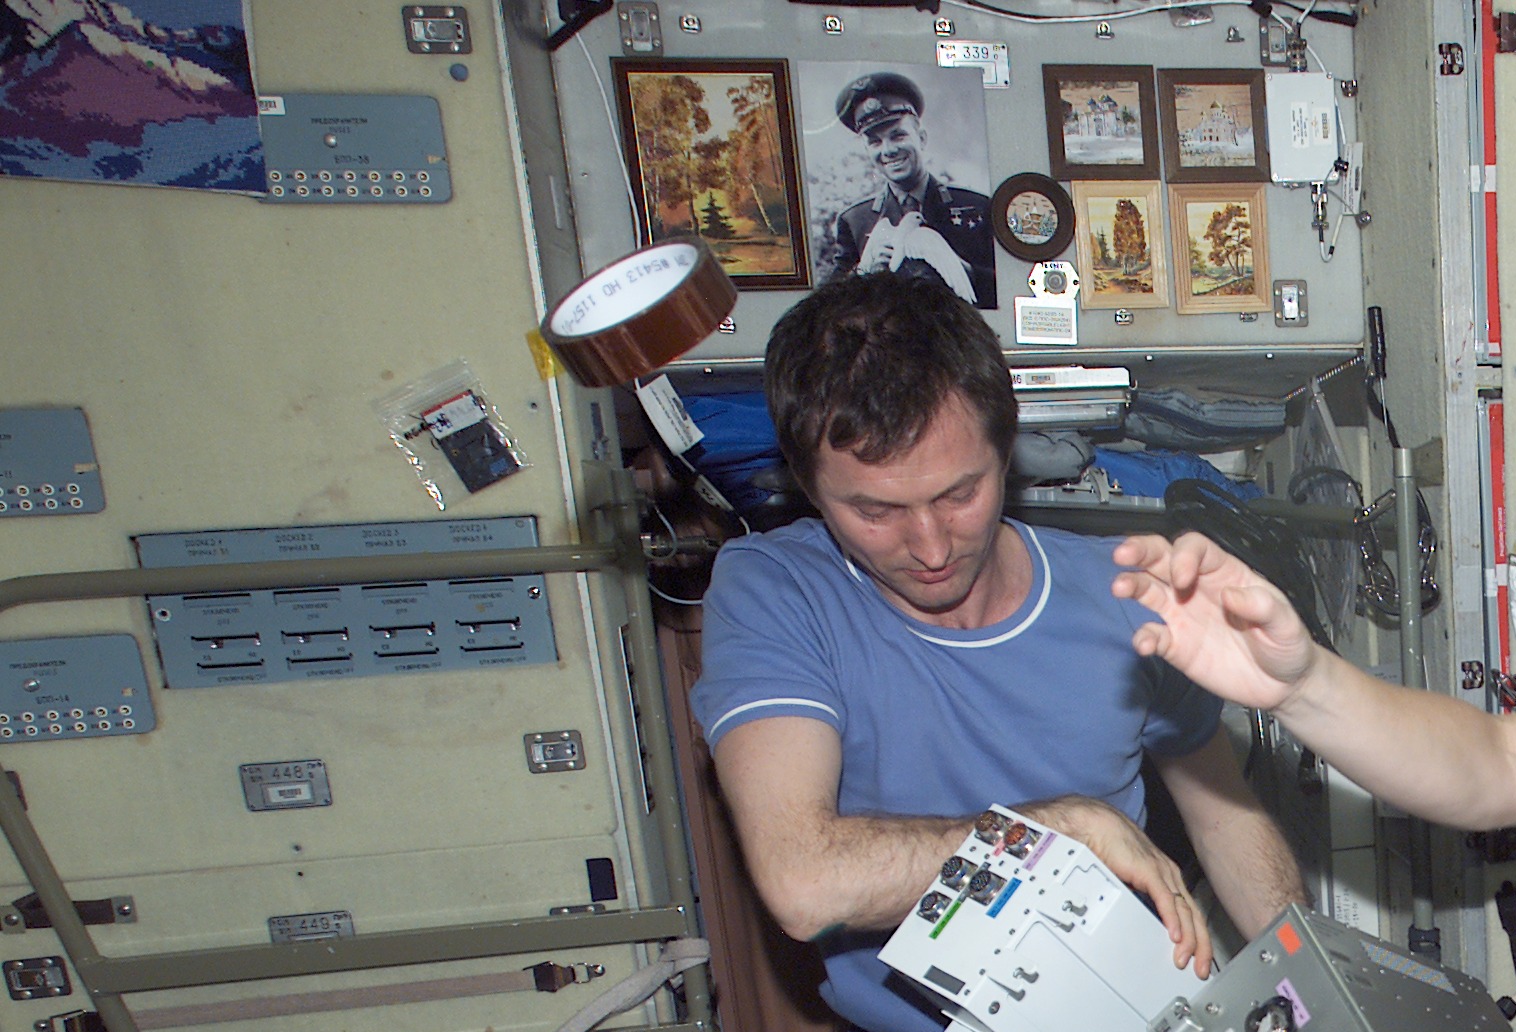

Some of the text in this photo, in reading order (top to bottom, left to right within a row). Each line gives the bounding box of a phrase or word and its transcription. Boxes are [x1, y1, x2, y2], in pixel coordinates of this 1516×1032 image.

[963, 45, 989, 59] 339
[273, 765, 303, 779] 448
[301, 917, 330, 930] 449
